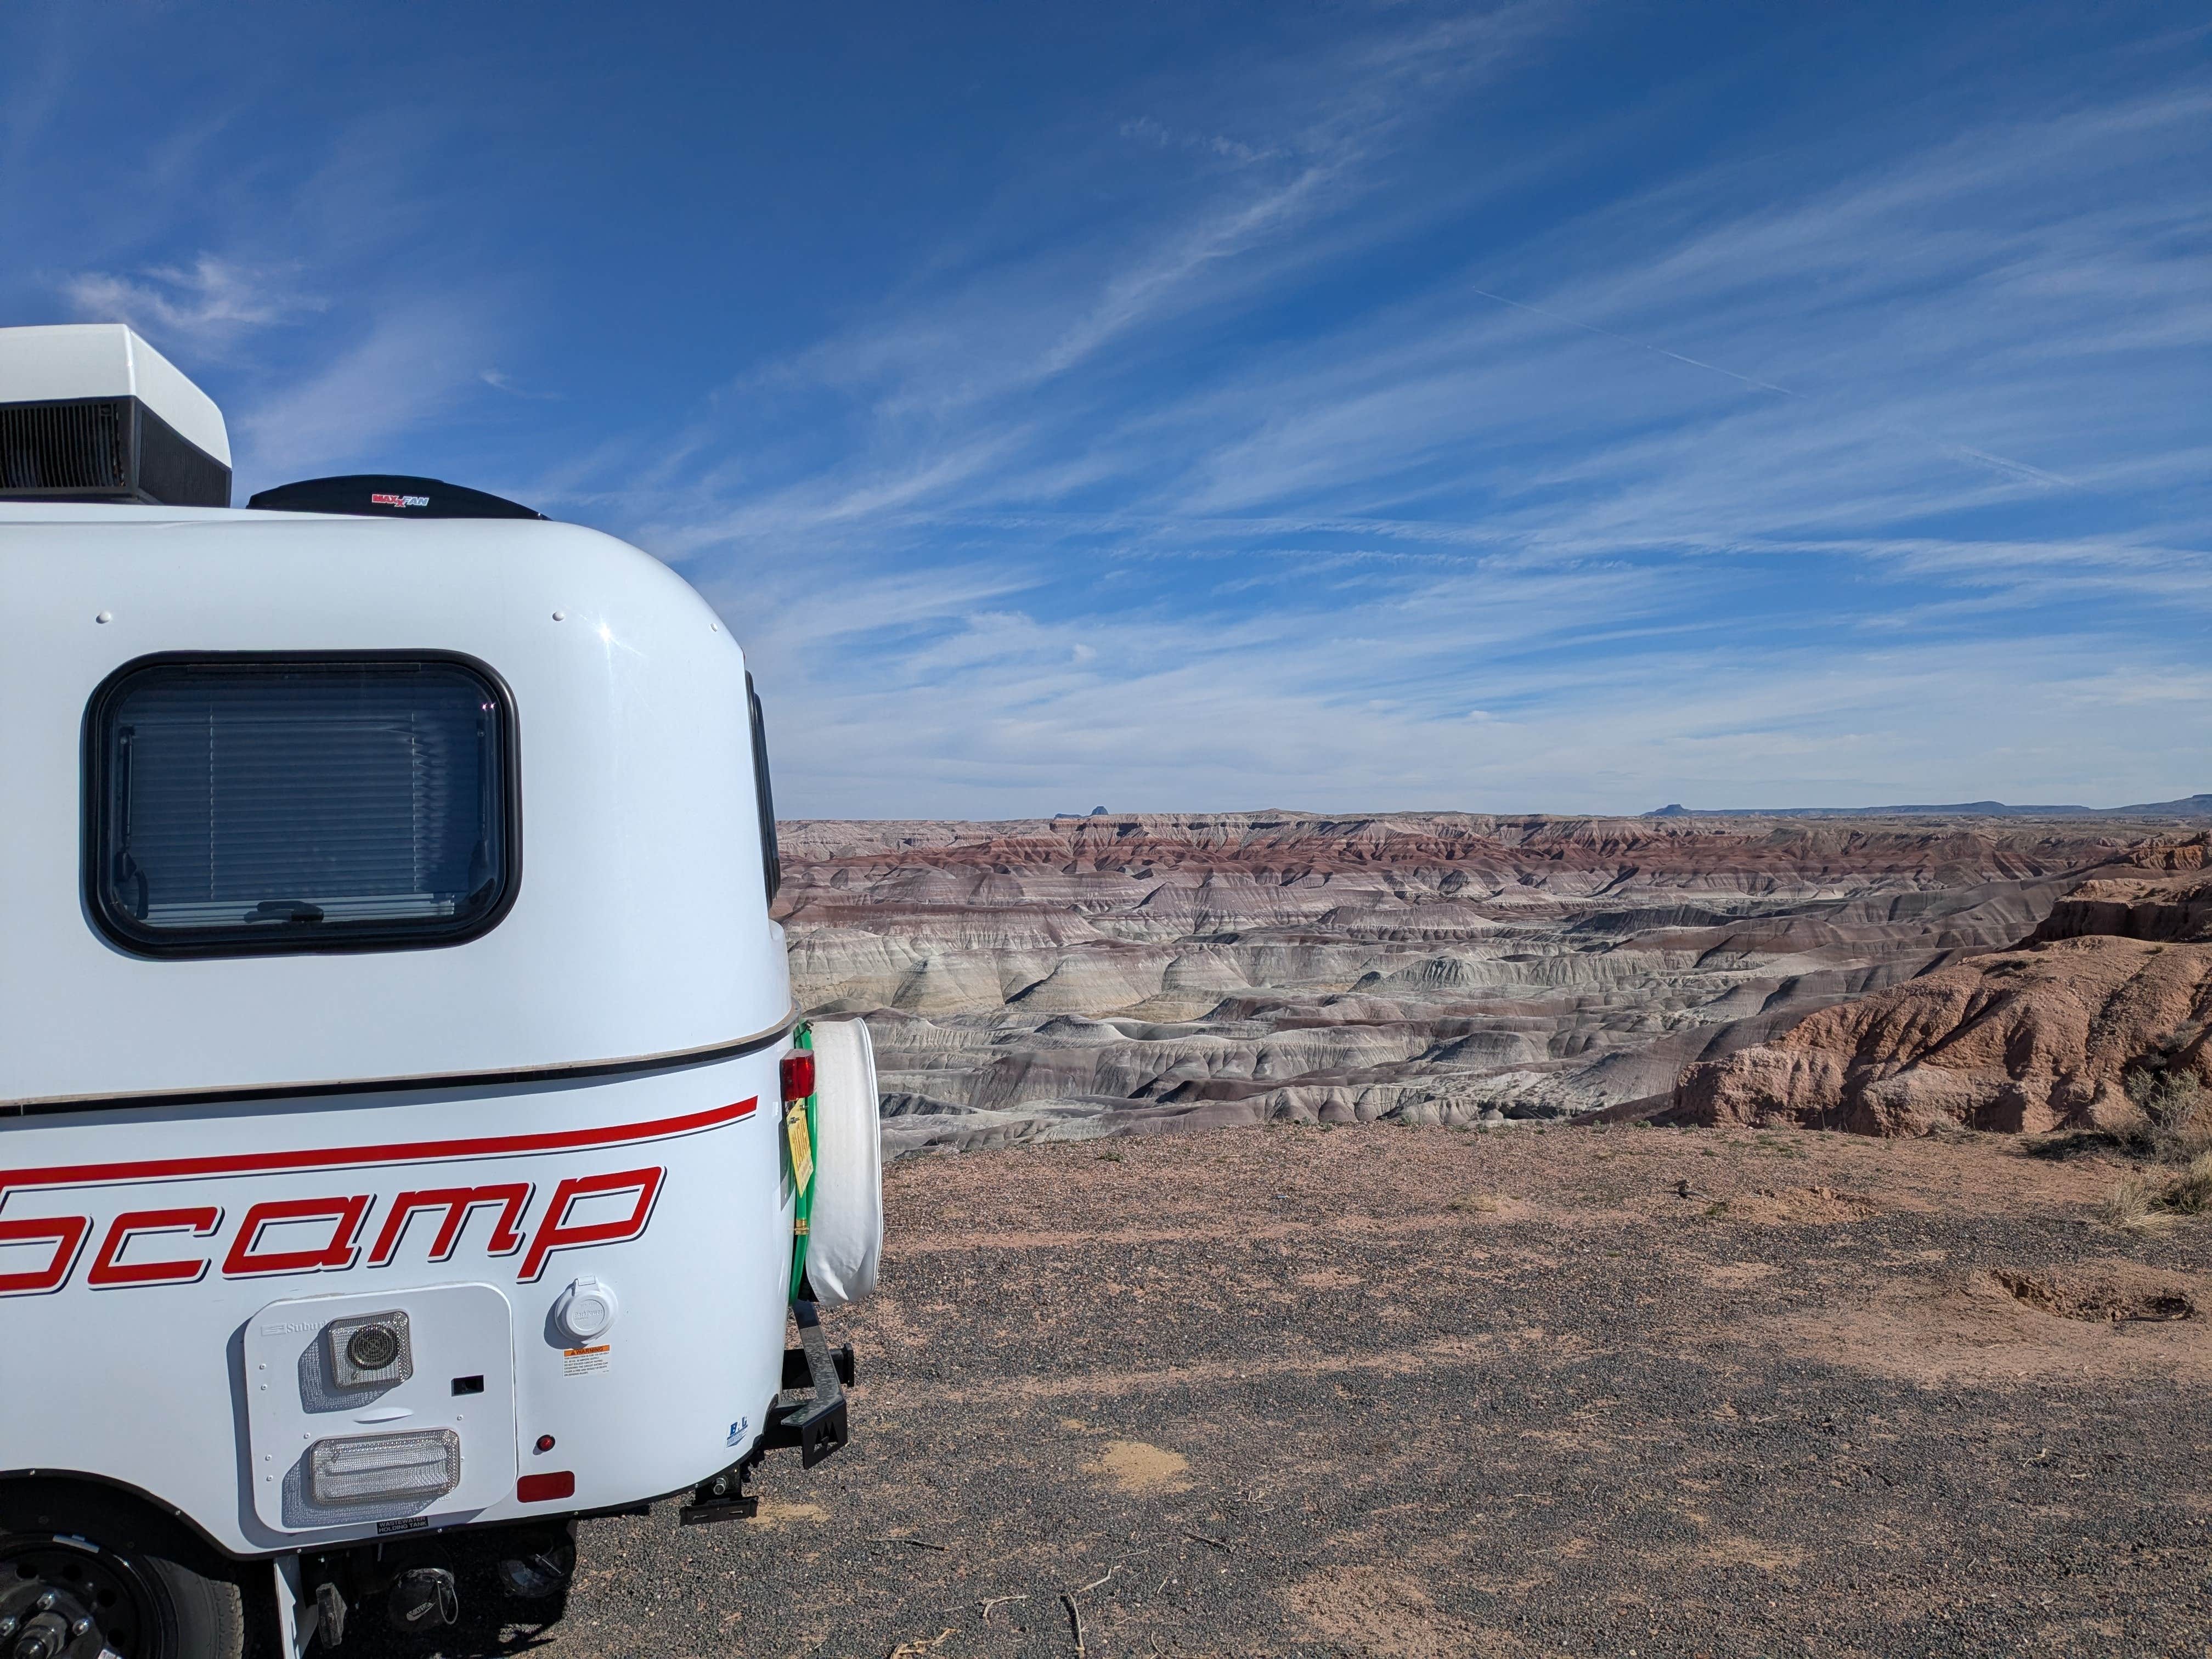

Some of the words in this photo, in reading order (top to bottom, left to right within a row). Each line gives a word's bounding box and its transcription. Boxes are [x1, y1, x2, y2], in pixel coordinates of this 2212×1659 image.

[576, 1346, 603, 1355] WARNING
[379, 1516, 426, 1527] WASTEWATER
[379, 1524, 408, 1532] HOLDING
